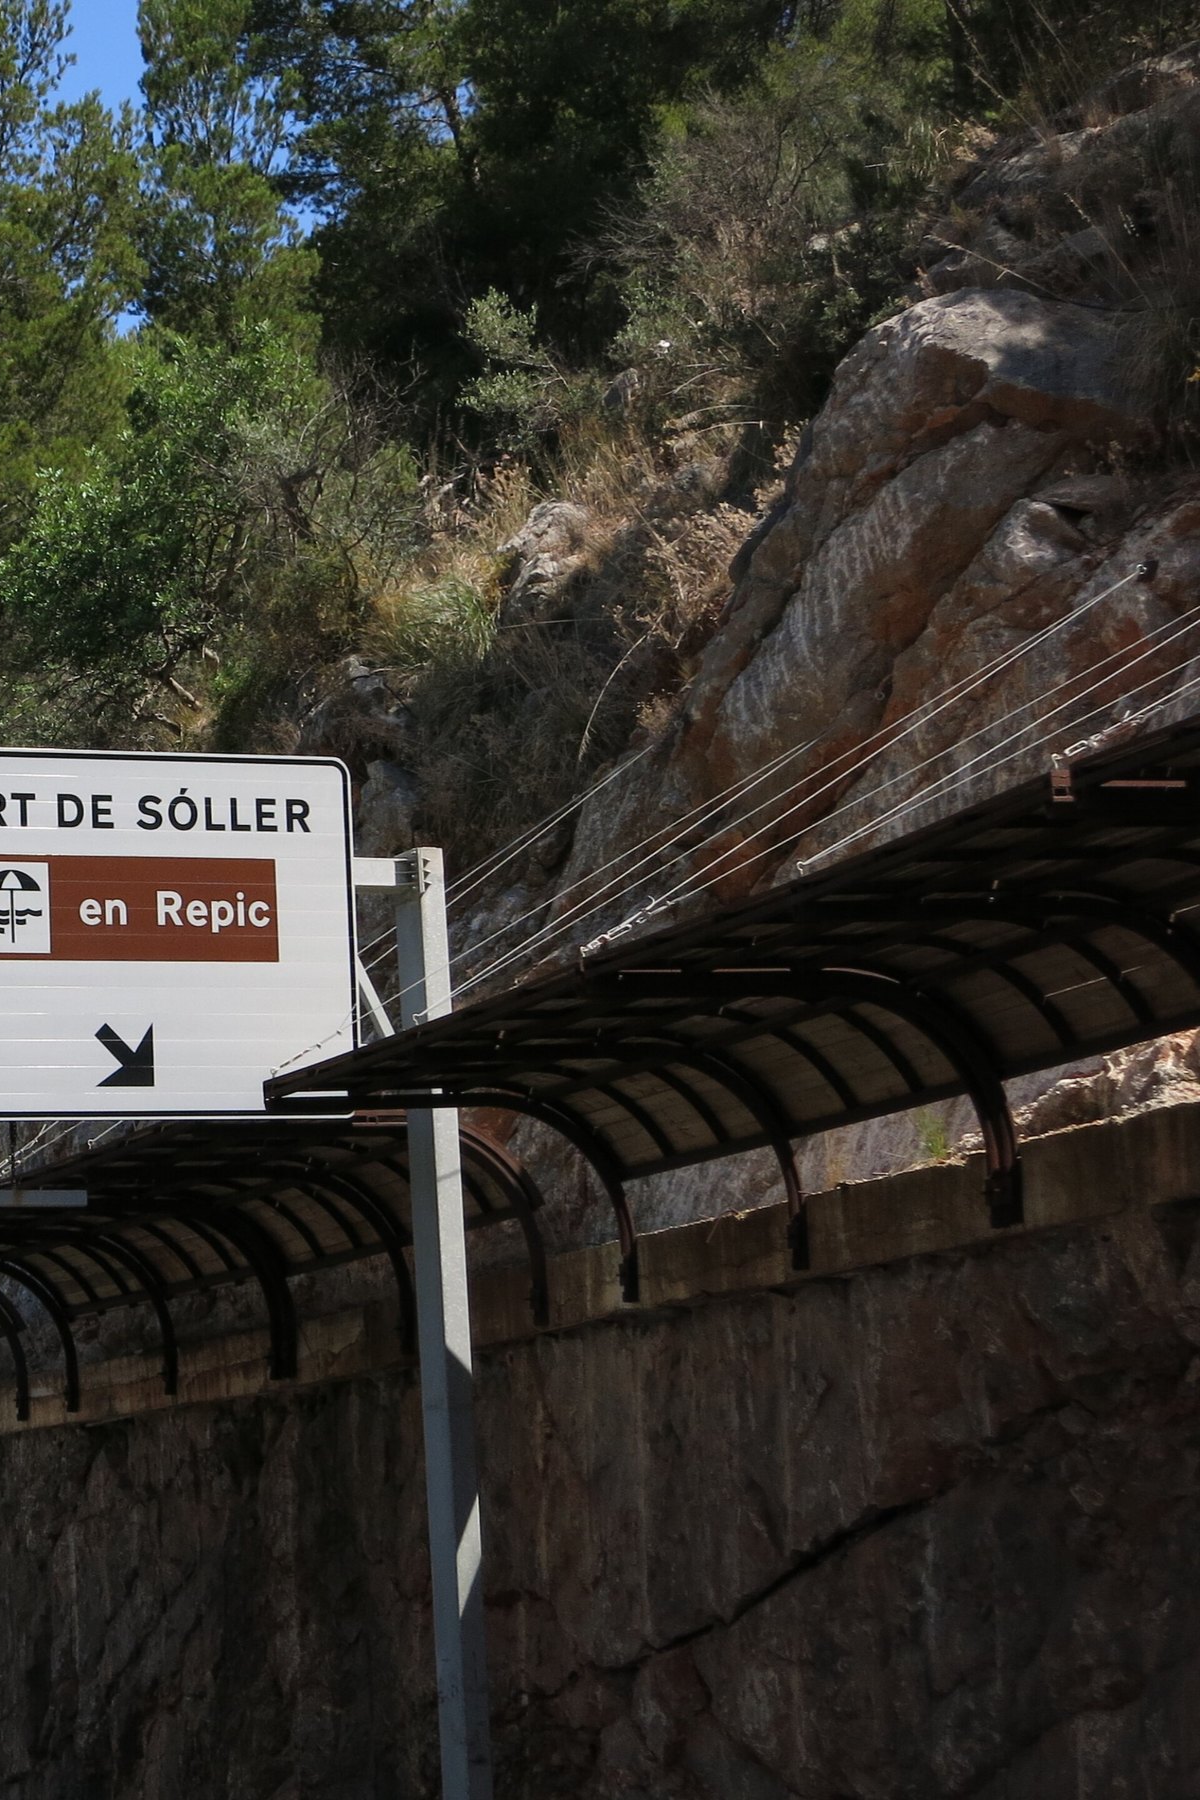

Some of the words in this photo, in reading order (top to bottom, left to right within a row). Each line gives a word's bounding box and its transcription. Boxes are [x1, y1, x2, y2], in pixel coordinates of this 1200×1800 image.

[56, 793, 116, 830] DE
[136, 786, 312, 834] SÓLLER
[79, 897, 129, 927] en
[155, 889, 272, 934] Repic
